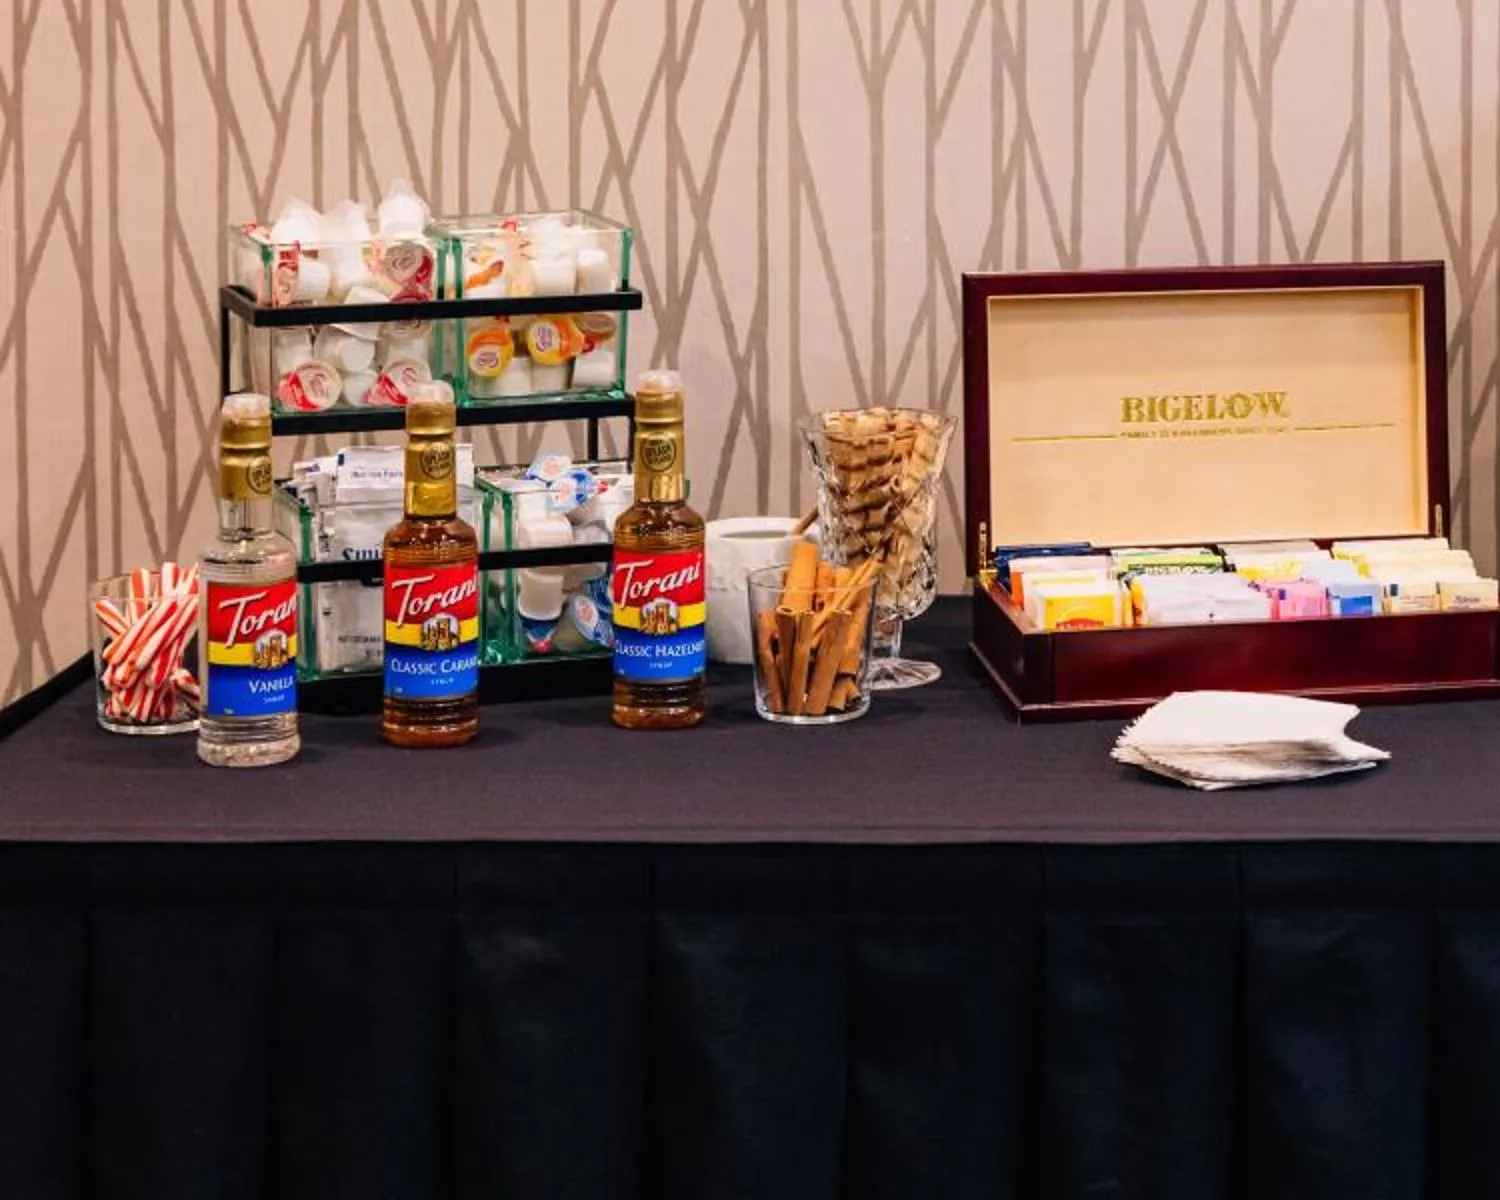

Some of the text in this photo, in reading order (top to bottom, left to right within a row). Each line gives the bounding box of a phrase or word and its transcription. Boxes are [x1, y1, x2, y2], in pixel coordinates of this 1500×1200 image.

[1121, 392, 1288, 422] BIGELOW
[616, 552, 703, 610] Torani
[391, 658, 437, 675] CLASSIC
